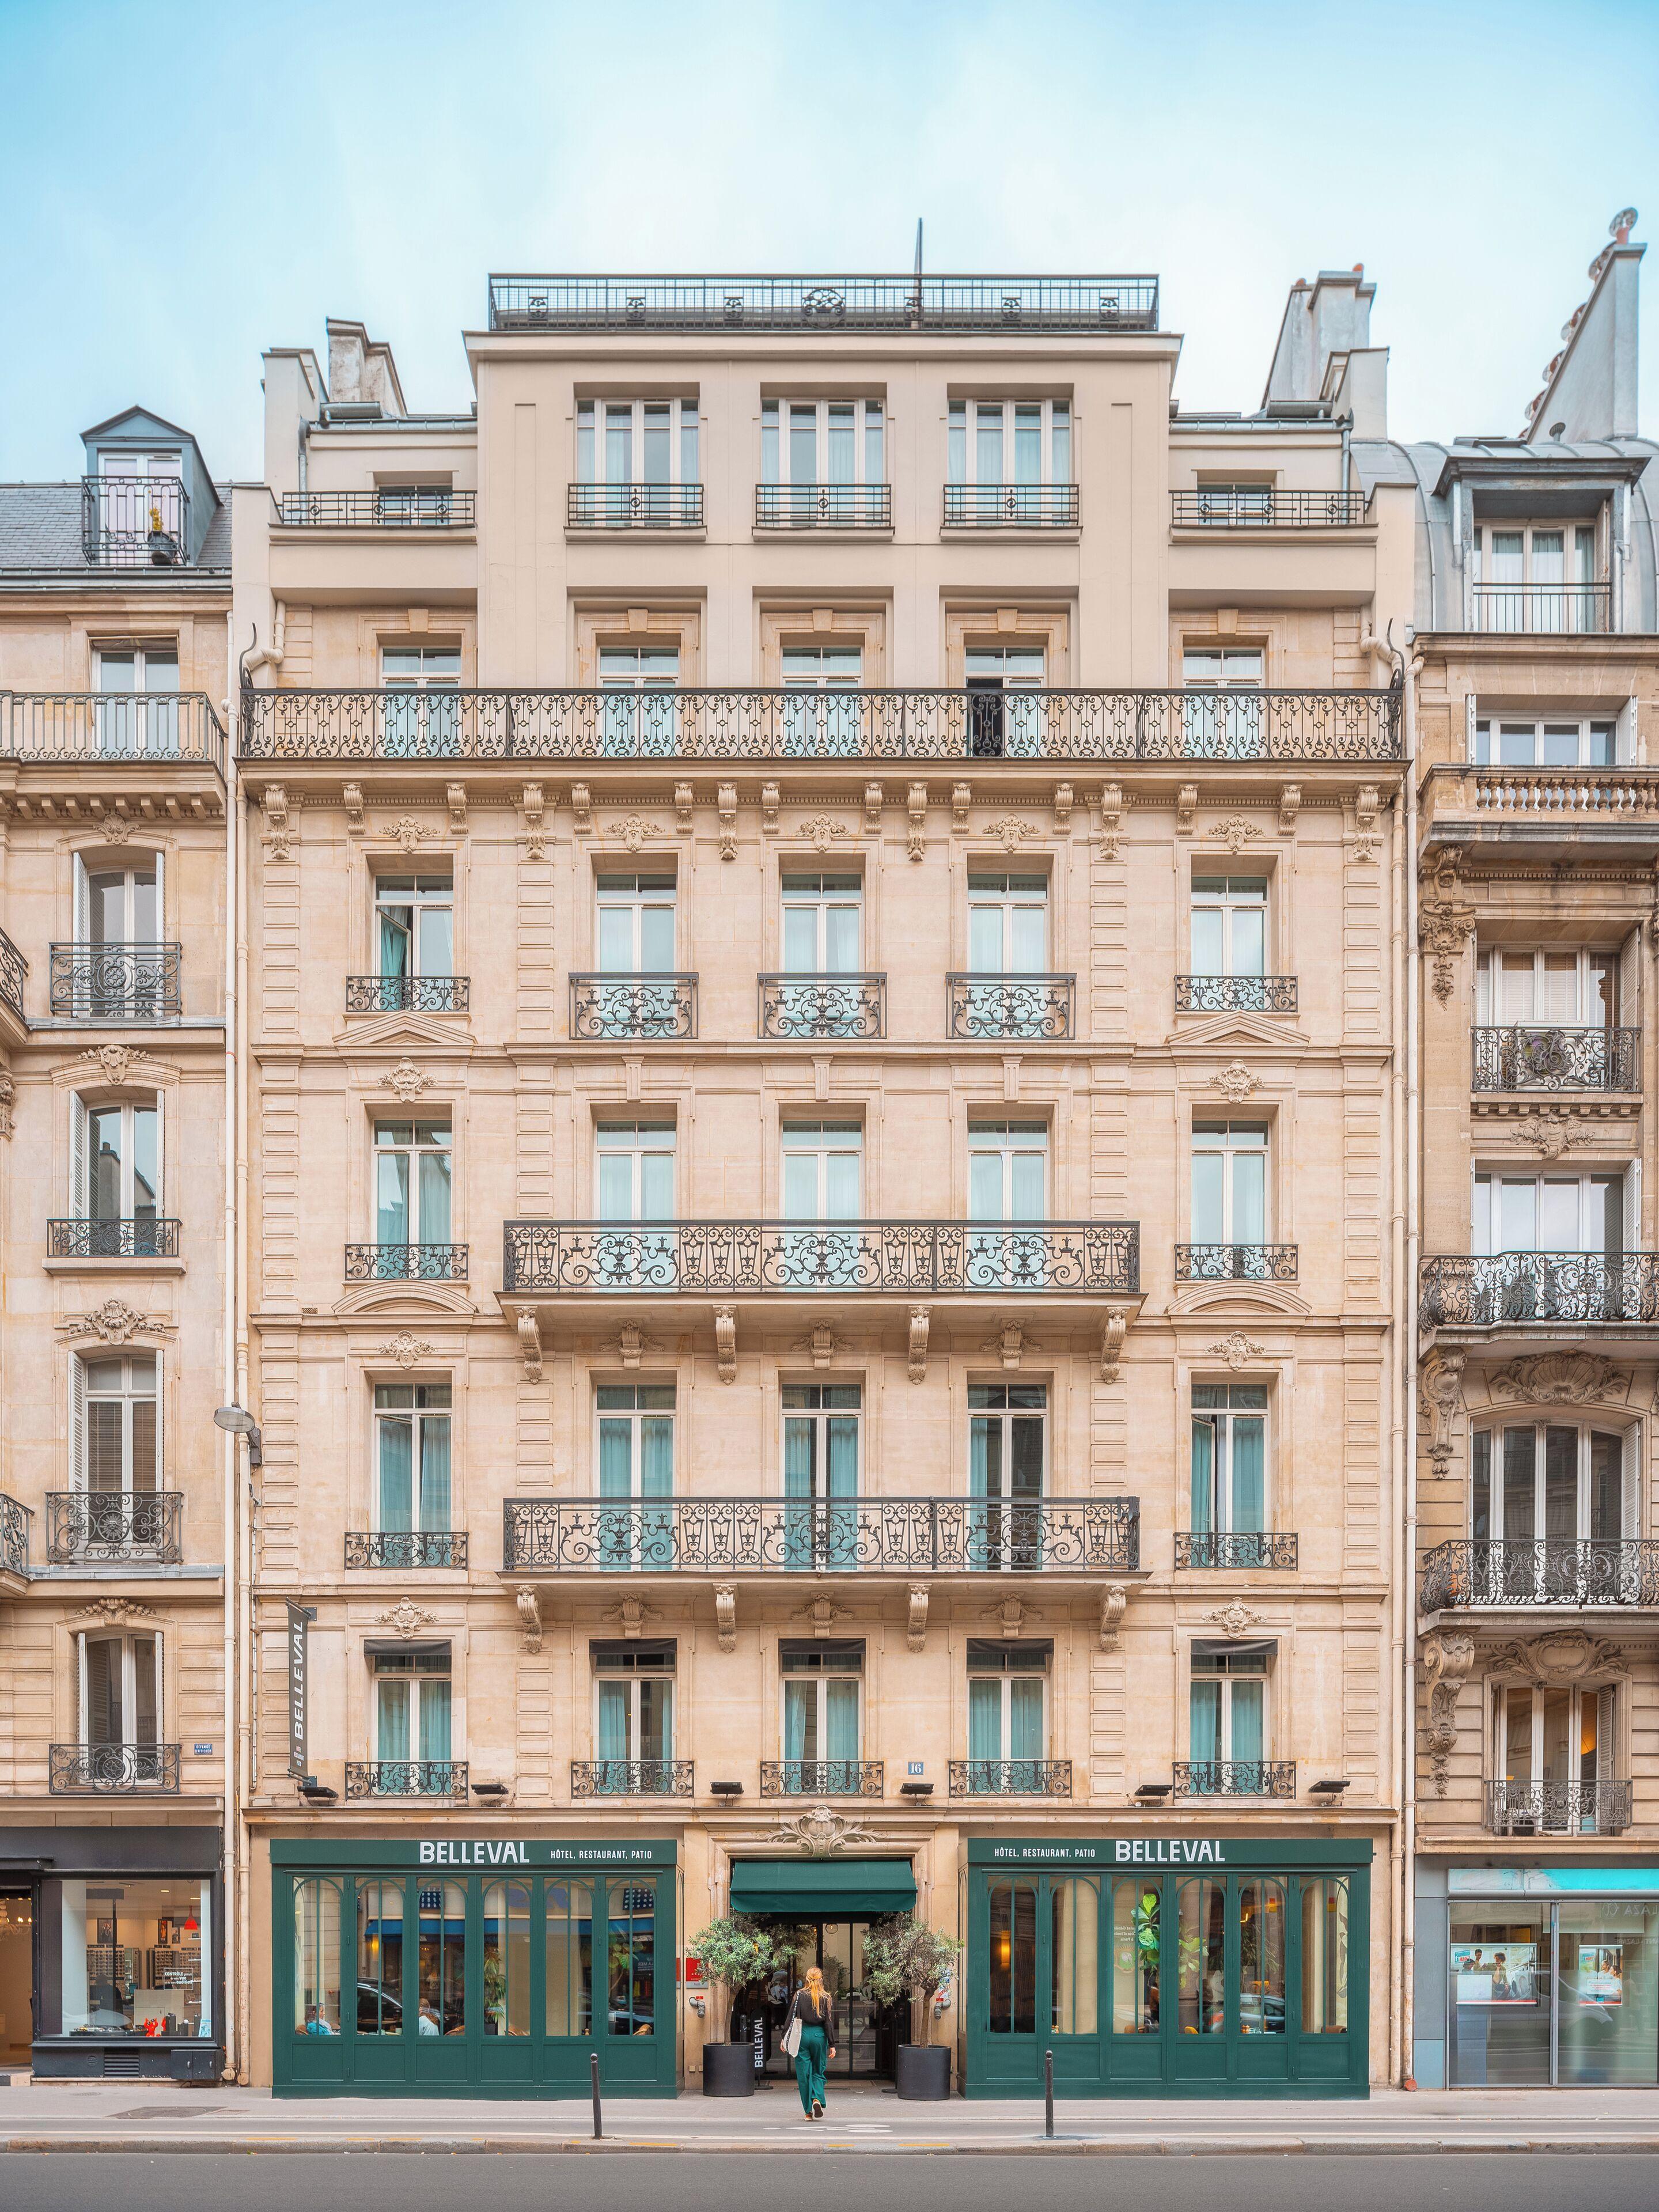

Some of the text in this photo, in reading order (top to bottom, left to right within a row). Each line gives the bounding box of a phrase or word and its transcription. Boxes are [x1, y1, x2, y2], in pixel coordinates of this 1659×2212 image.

[294, 1621, 303, 1740] BELLEVAL
[911, 1763, 922, 1774] 16
[419, 1842, 652, 1863] BELLEVAL HÔTEL, RESTAURANT, PATIO
[994, 1840, 1225, 1862] HÔTEL, RESTAURANT, PATIO BELLEVAL
[754, 2017, 763, 2068] BELLEVAL
